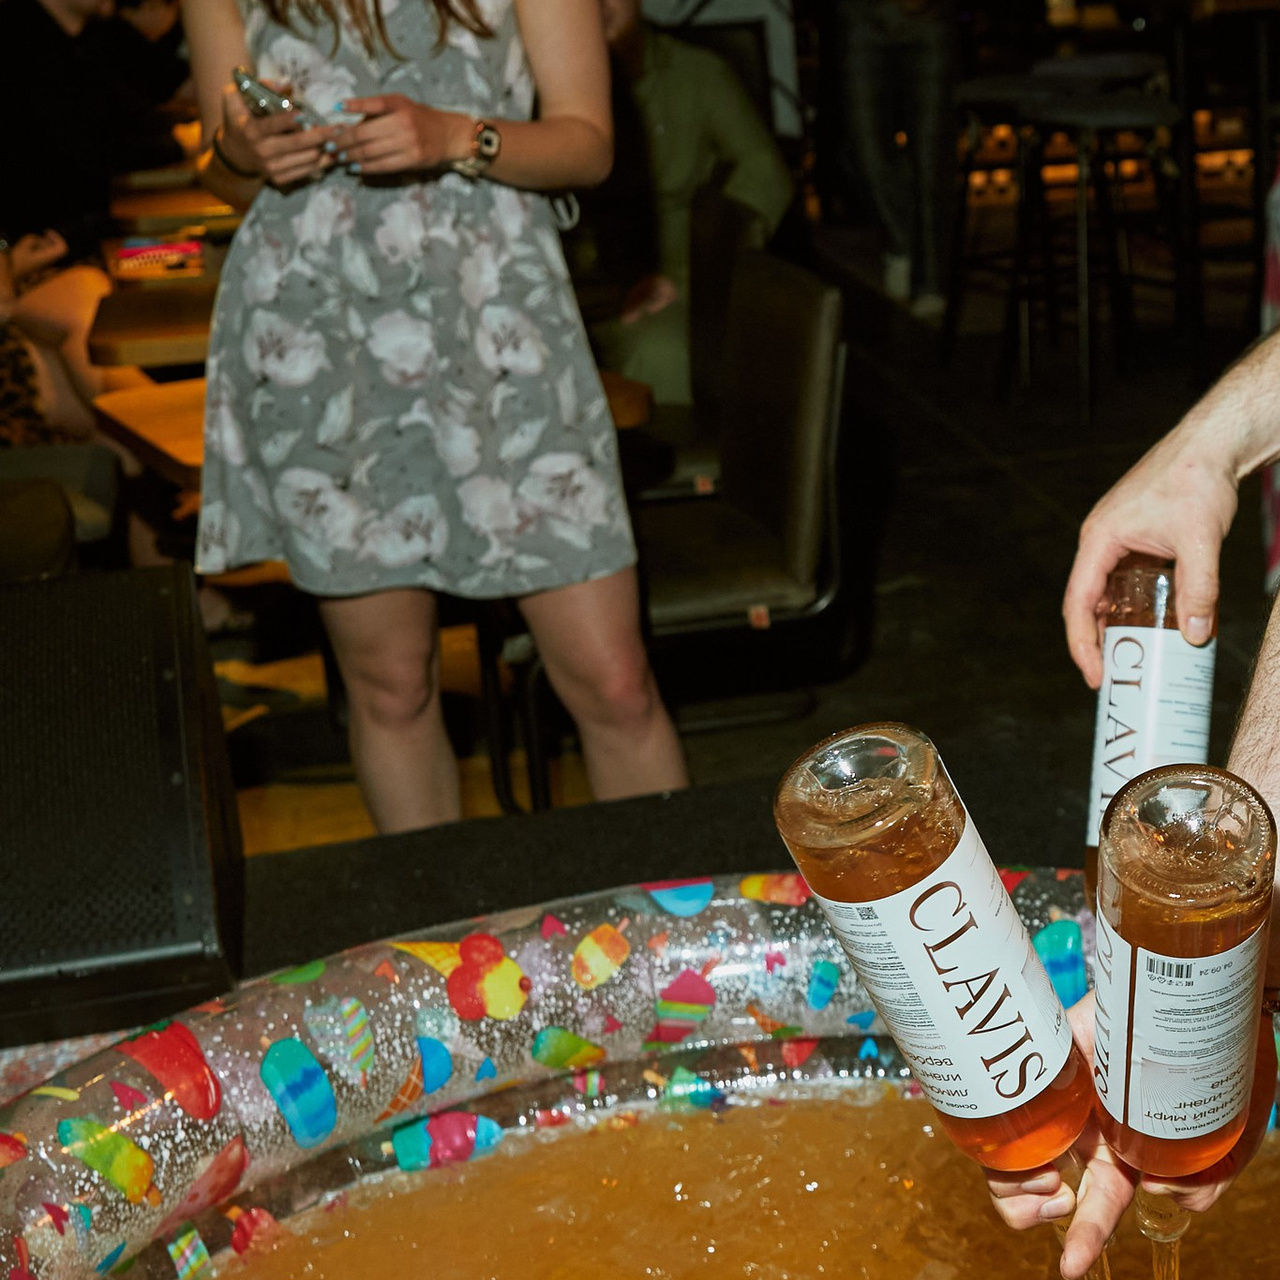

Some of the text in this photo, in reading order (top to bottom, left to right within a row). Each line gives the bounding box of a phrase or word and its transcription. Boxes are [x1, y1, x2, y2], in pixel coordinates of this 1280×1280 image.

[1100, 635, 1146, 812] CLAV
[906, 880, 1047, 1100] CLAVIS
[1143, 1110, 1187, 1122] мирт
